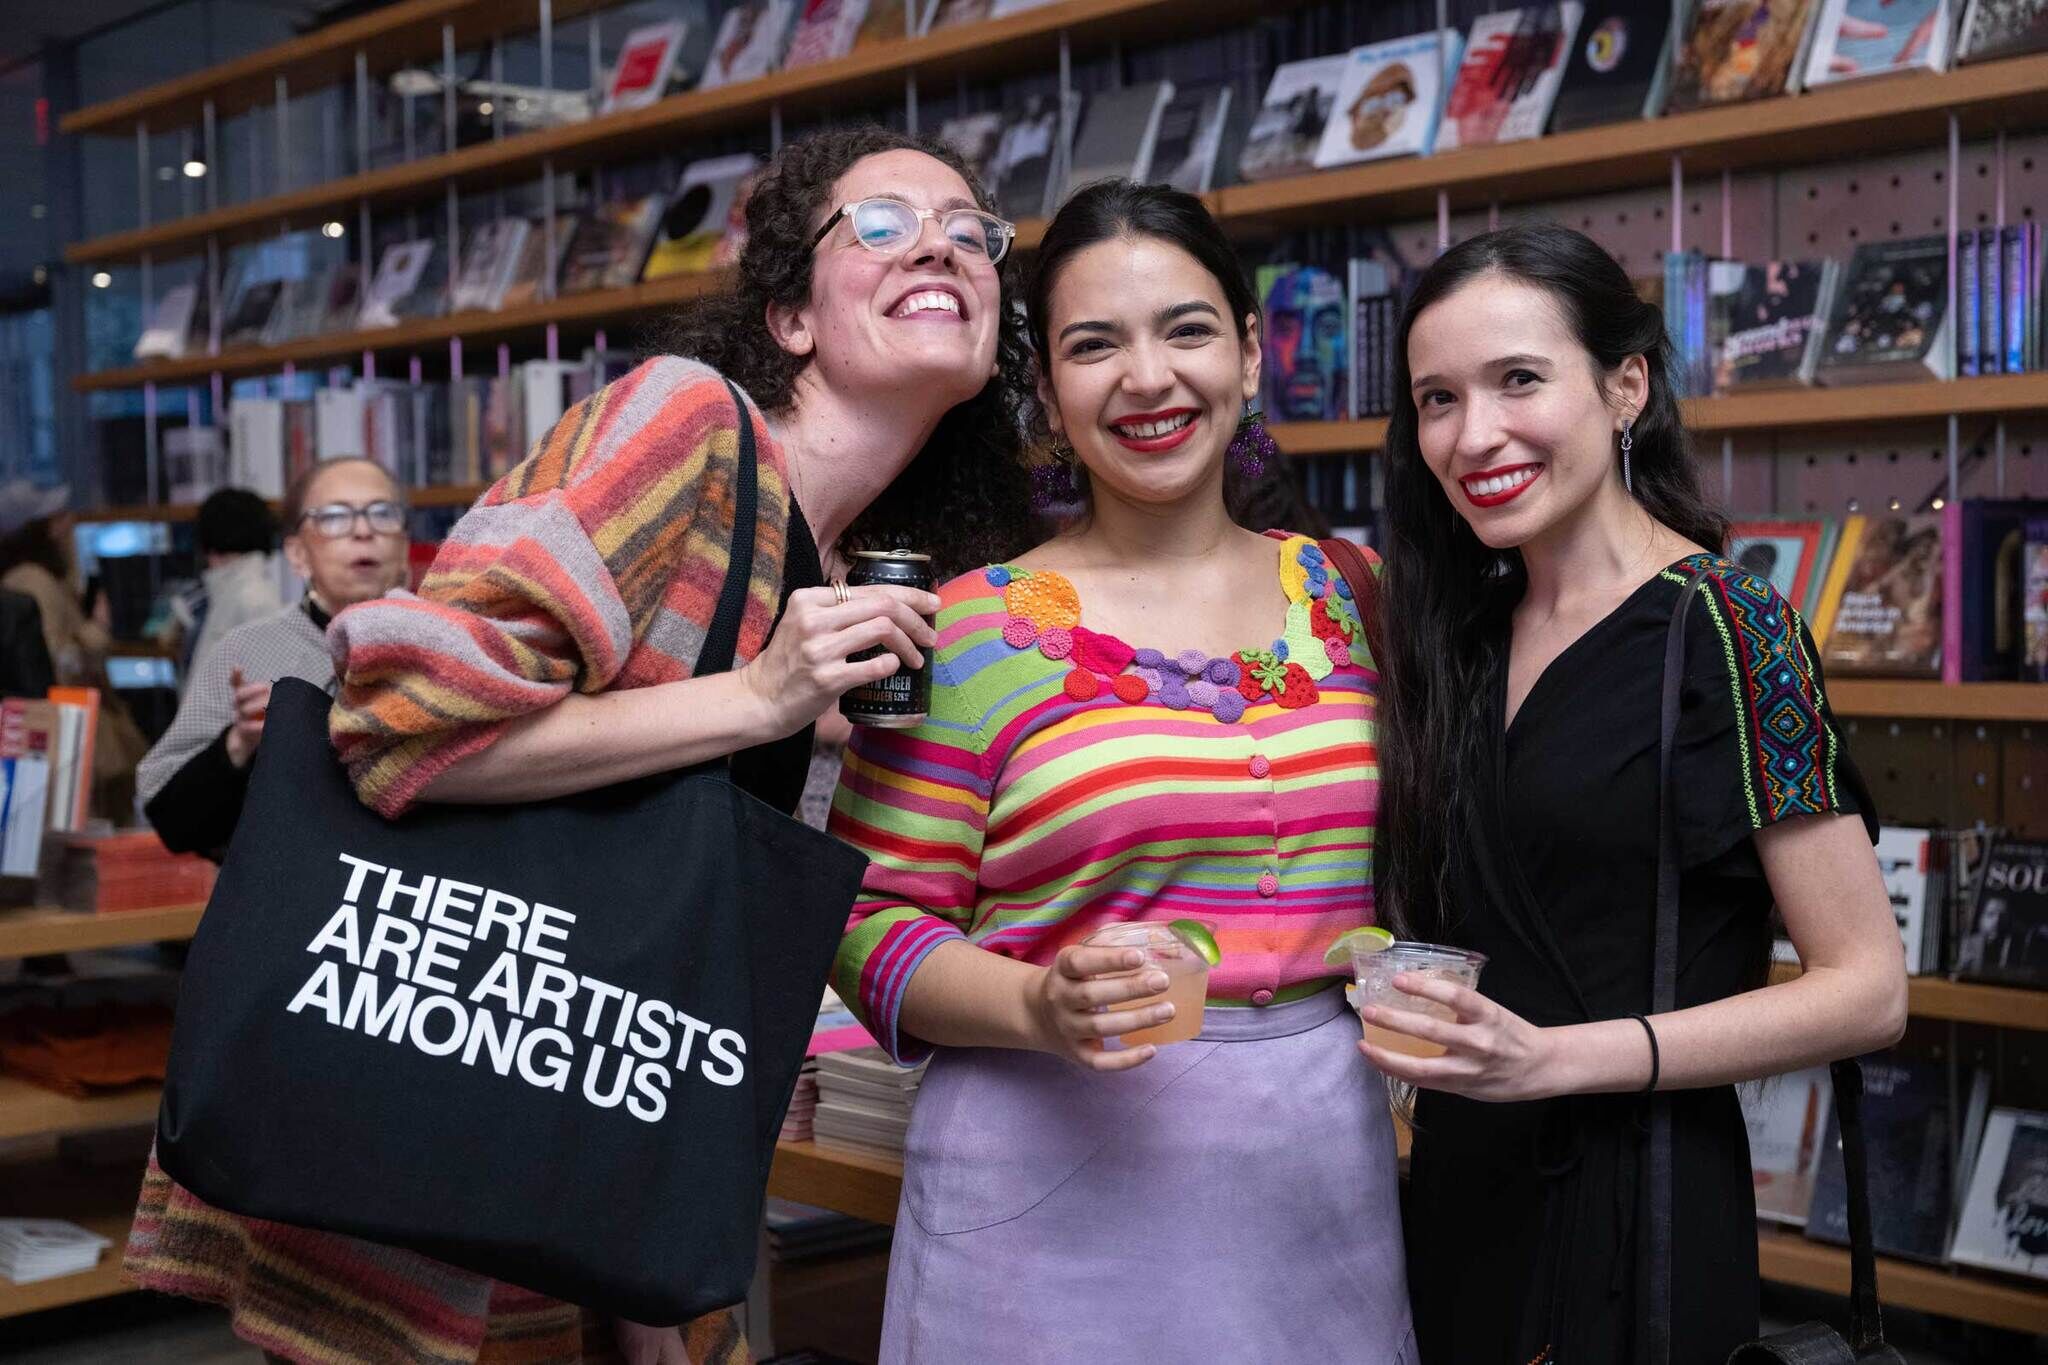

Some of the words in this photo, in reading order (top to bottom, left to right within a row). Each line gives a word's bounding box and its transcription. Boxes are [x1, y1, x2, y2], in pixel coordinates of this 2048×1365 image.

[885, 676, 910, 691] LAGER
[339, 852, 577, 964] THERE
[286, 960, 574, 1093] AMONG
[582, 1044, 672, 1123] US
[306, 903, 470, 994] ARE
[468, 951, 747, 1086] ARTISTS
